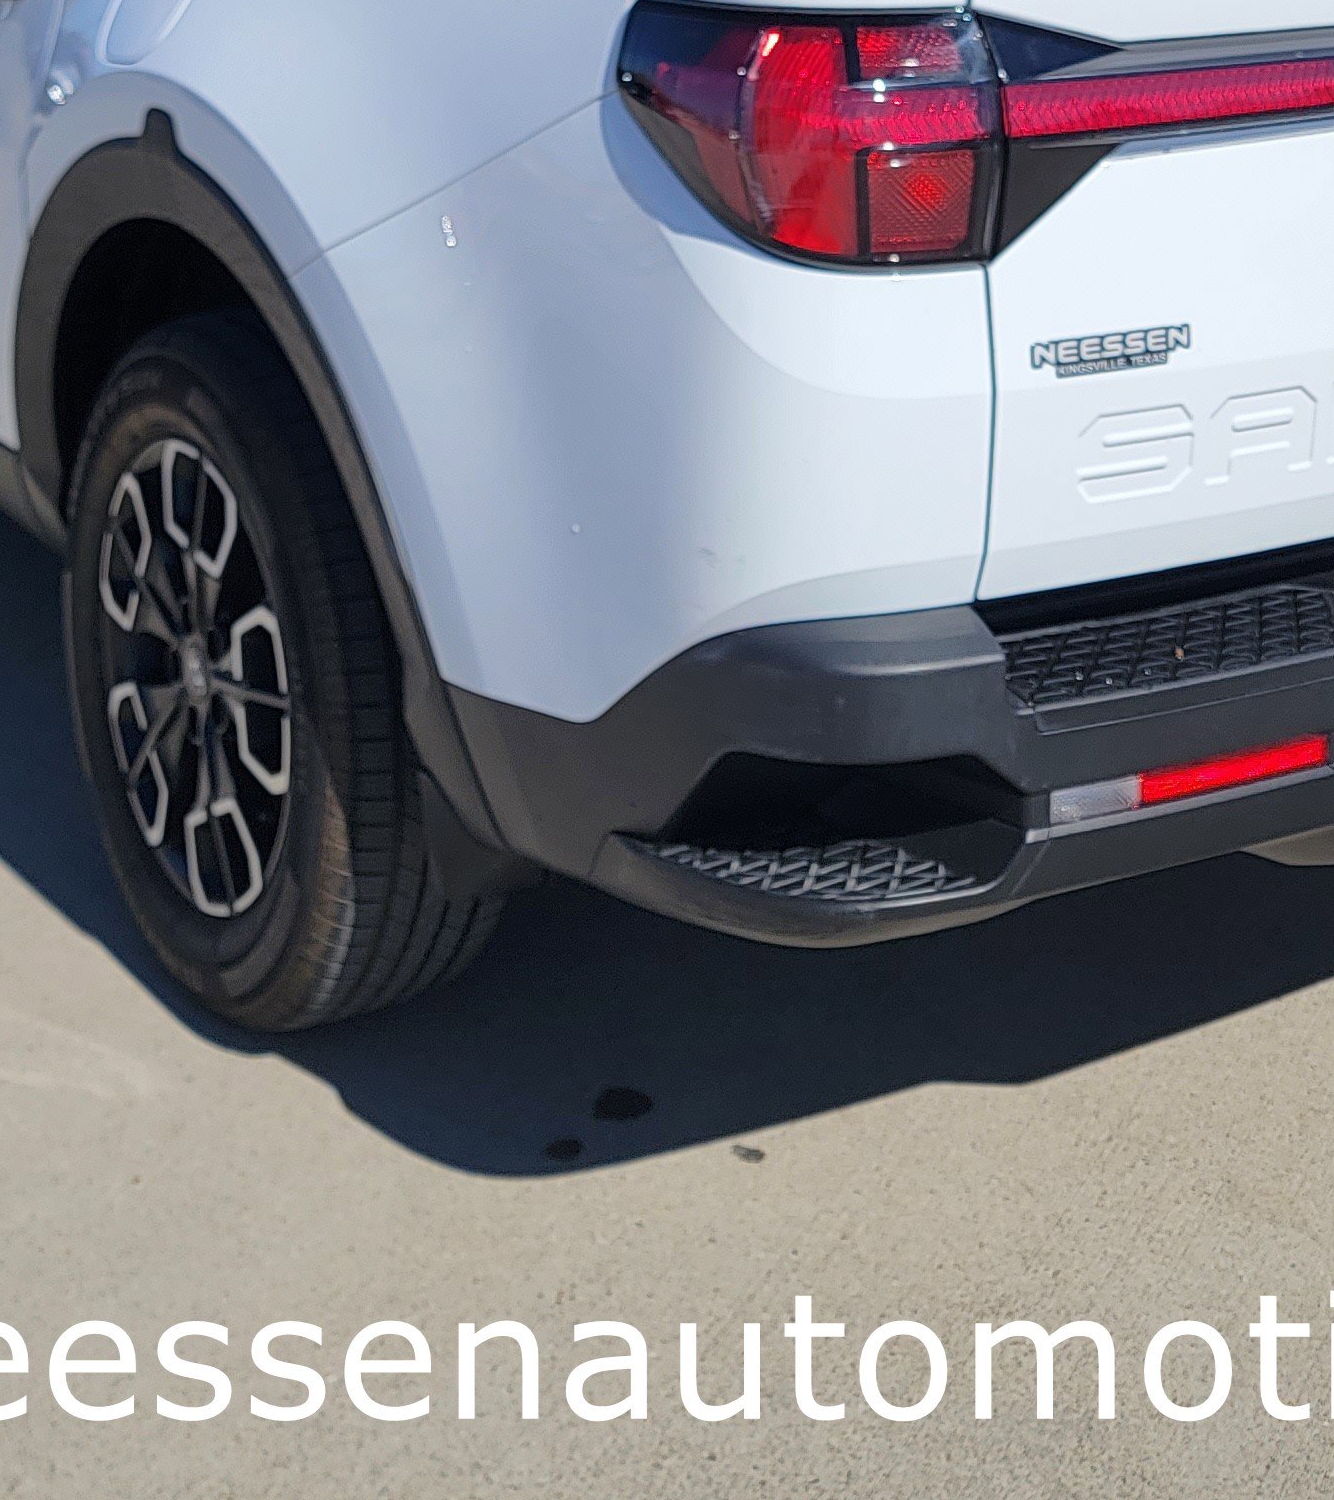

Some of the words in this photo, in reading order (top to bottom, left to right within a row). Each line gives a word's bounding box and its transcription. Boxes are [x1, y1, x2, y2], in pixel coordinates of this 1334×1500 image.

[1031, 324, 1191, 369] NEESSEN
[1058, 358, 1127, 376] KINGSVILLE
[1130, 352, 1167, 368] TEXAS
